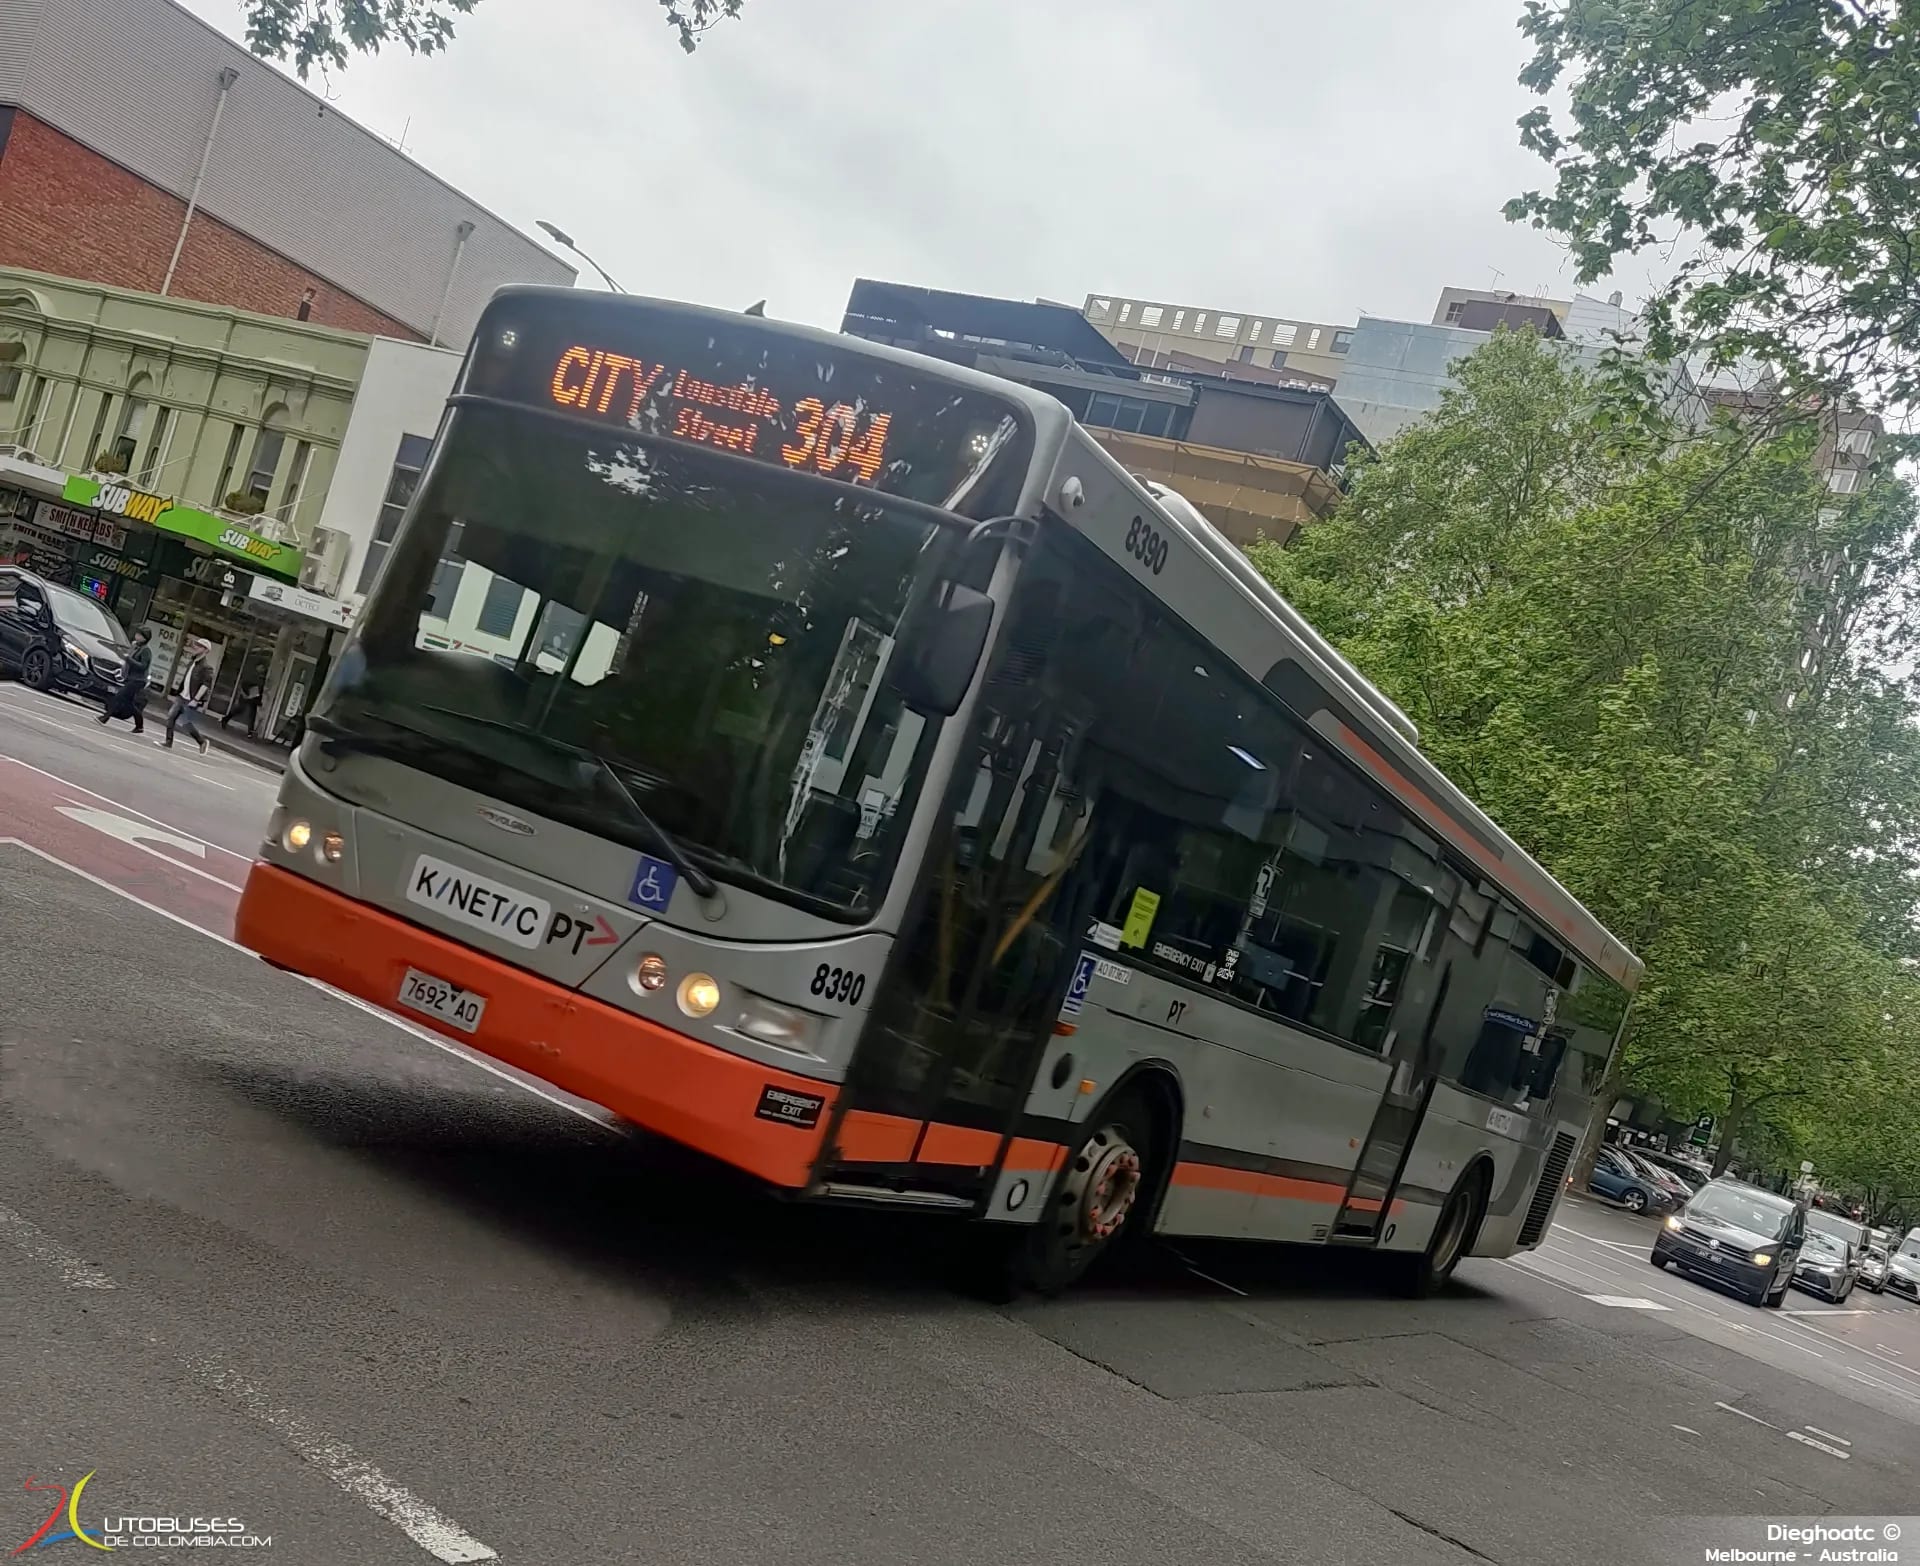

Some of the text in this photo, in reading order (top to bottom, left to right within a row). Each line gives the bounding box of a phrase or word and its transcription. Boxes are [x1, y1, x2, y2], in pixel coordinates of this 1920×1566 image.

[552, 345, 664, 421] CITY
[672, 369, 783, 417] Lonsdale
[672, 408, 760, 453] Street
[782, 397, 892, 481] 304
[91, 483, 173, 524] SUBWAY
[219, 528, 281, 560] SUBWAY
[1126, 515, 1168, 576] 8390
[90, 552, 148, 580] SUBWAY
[1153, 942, 1190, 967] EMERGENCY
[1191, 957, 1205, 974] EXIT
[408, 976, 448, 1011] 7692
[811, 963, 866, 1006] 8390
[766, 1089, 821, 1110] EMERGENCY
[781, 1104, 803, 1117] EXIT
